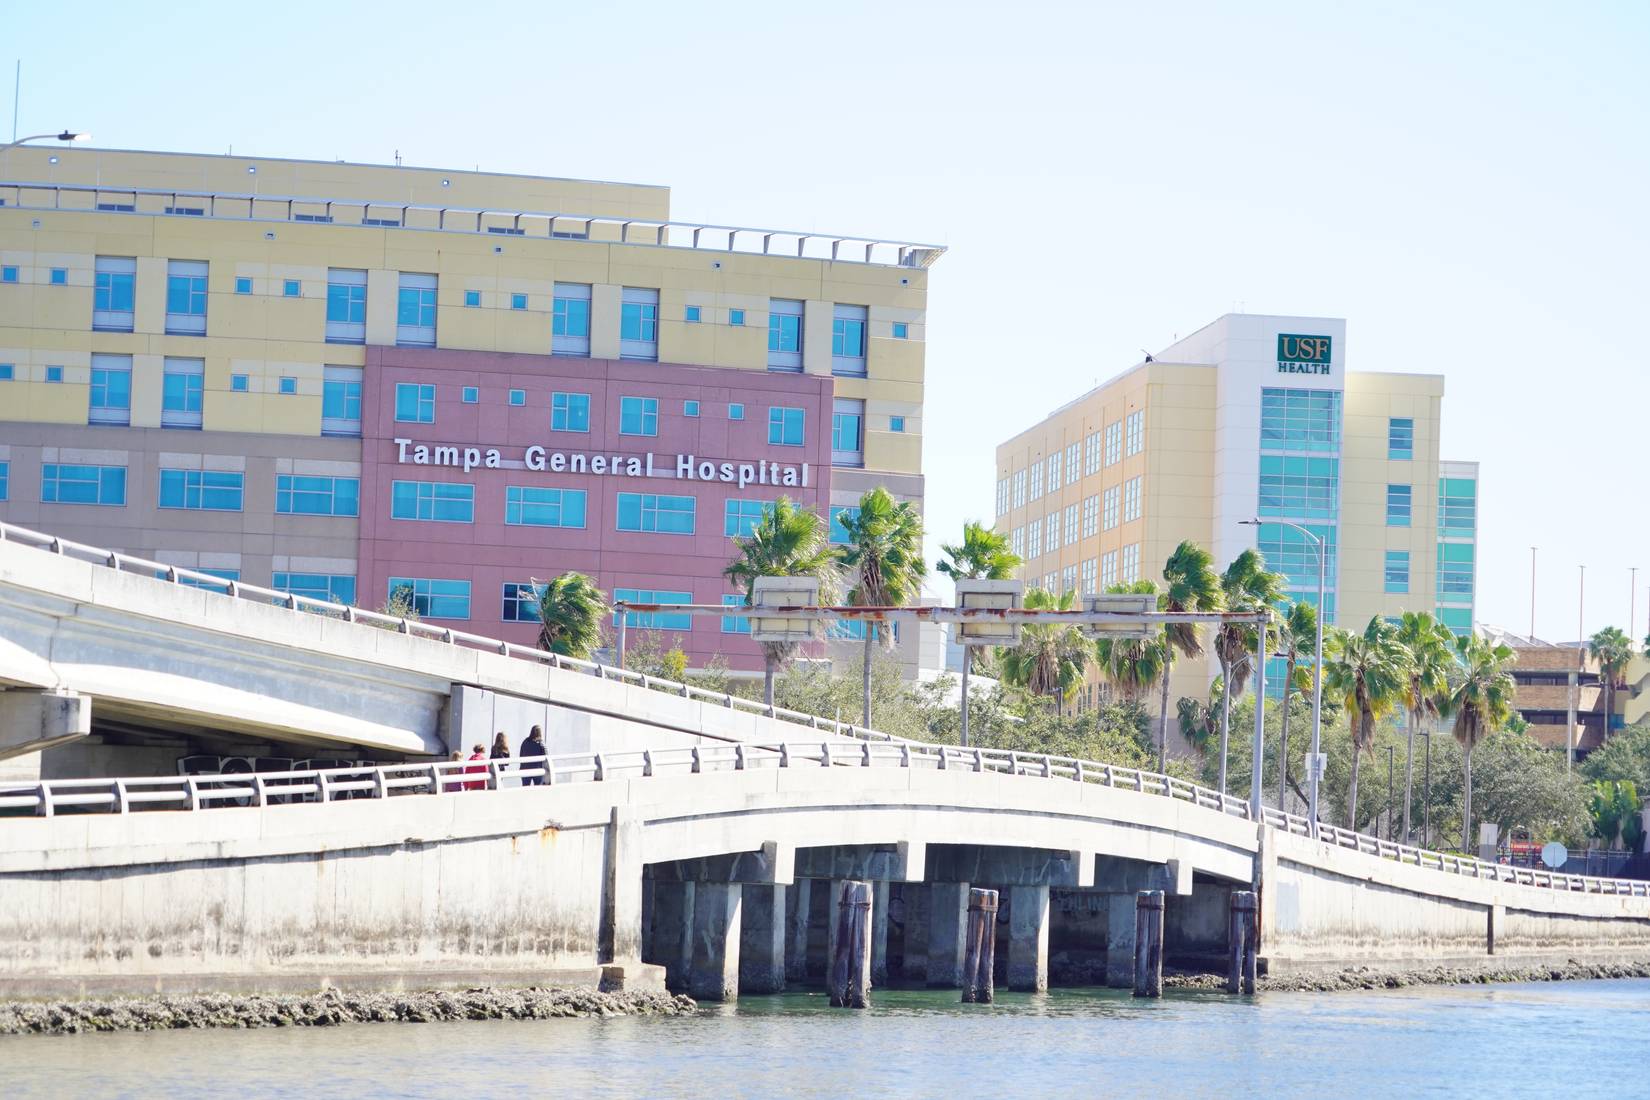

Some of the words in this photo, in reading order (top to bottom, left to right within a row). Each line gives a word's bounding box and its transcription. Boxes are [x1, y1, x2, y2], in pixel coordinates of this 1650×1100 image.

[1282, 336, 1329, 360] USF
[1278, 362, 1330, 375] HEALTH
[394, 438, 501, 473] Tampa
[525, 445, 653, 477] General
[677, 454, 809, 488] Hospital
